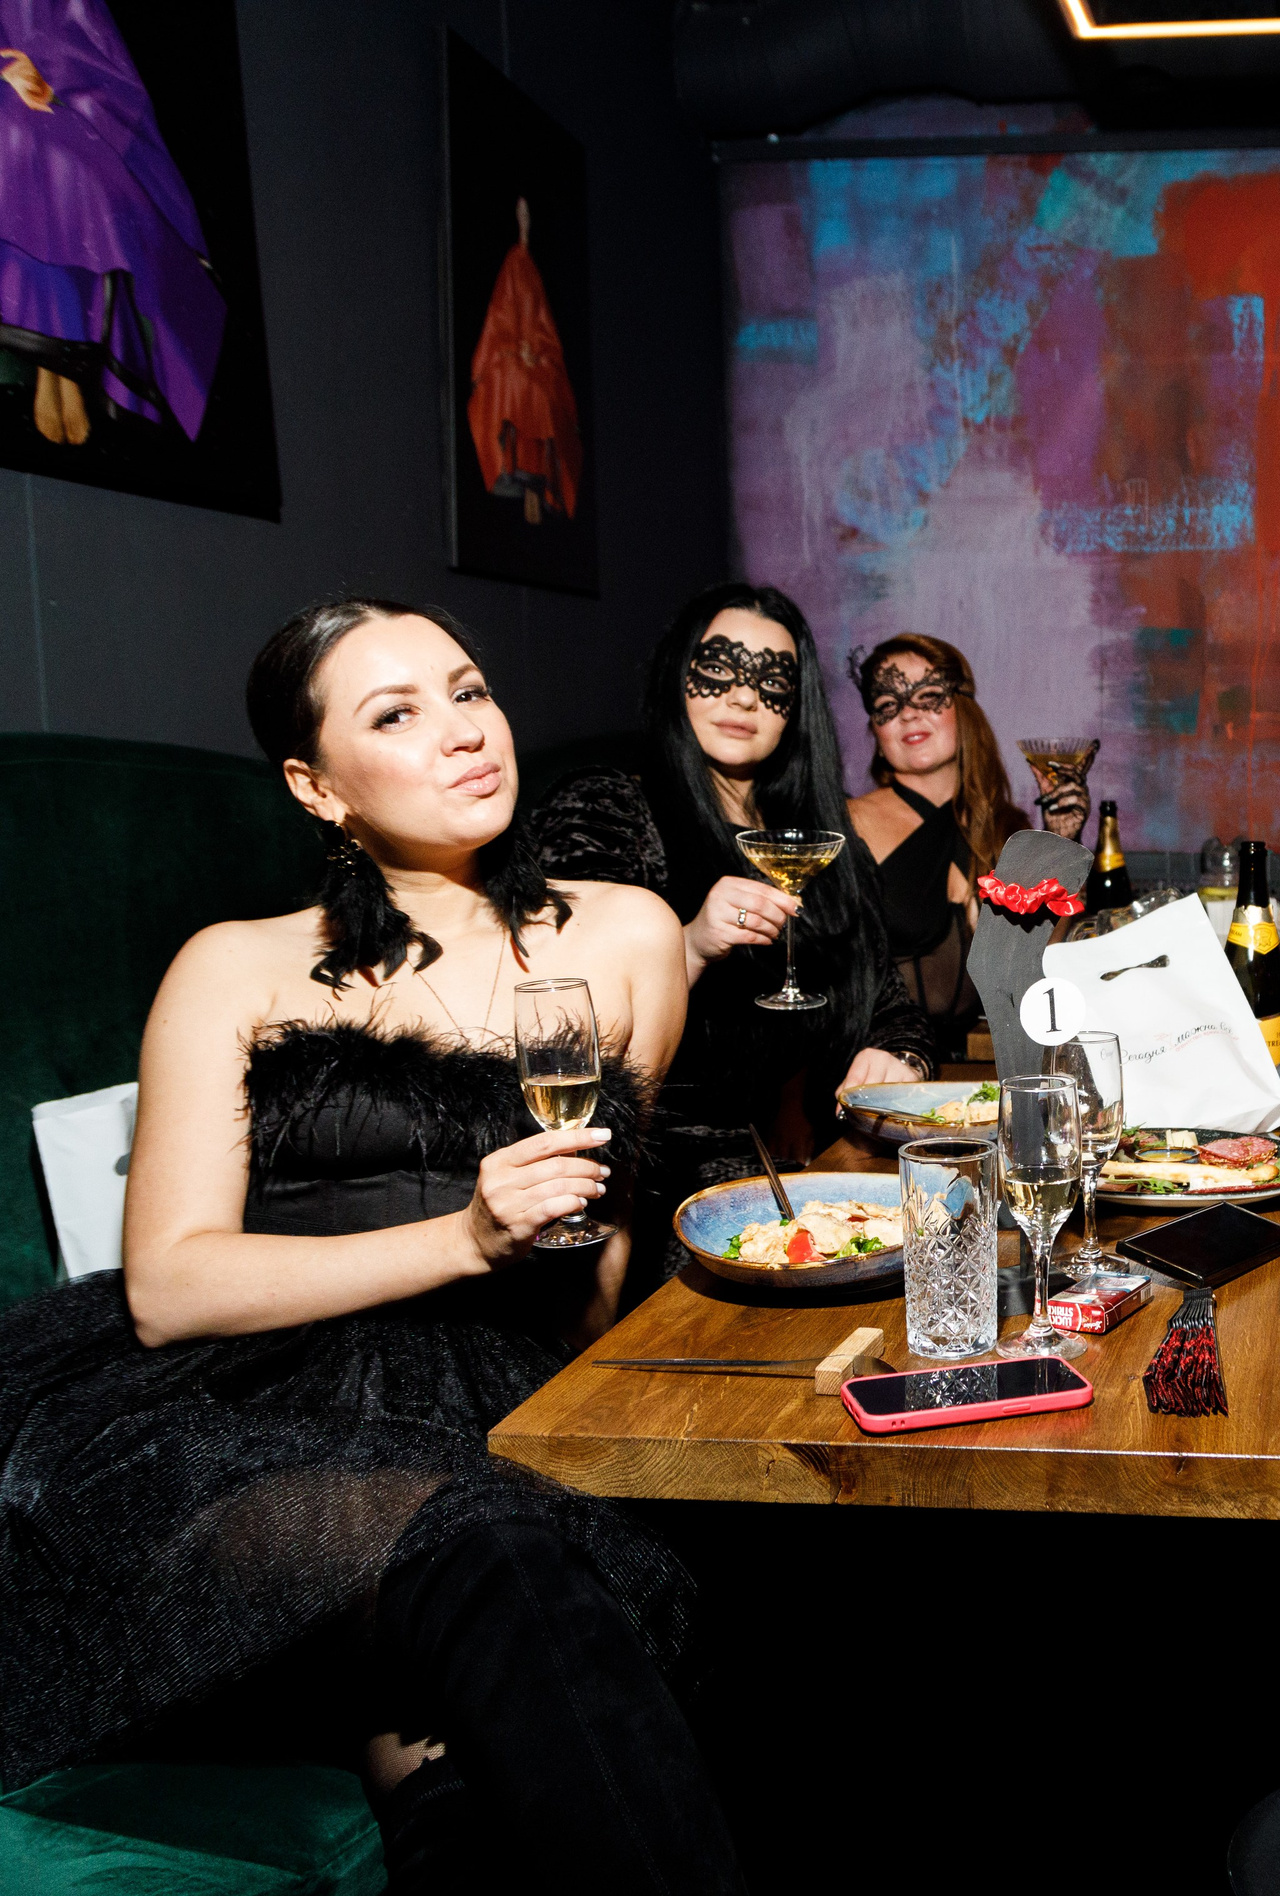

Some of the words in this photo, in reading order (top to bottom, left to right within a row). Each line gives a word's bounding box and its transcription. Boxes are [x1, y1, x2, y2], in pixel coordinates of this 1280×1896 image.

[1043, 988, 1062, 1033] 1
[1048, 1305, 1074, 1317] STRIKE
[1049, 1316, 1072, 1327] LUCKY
